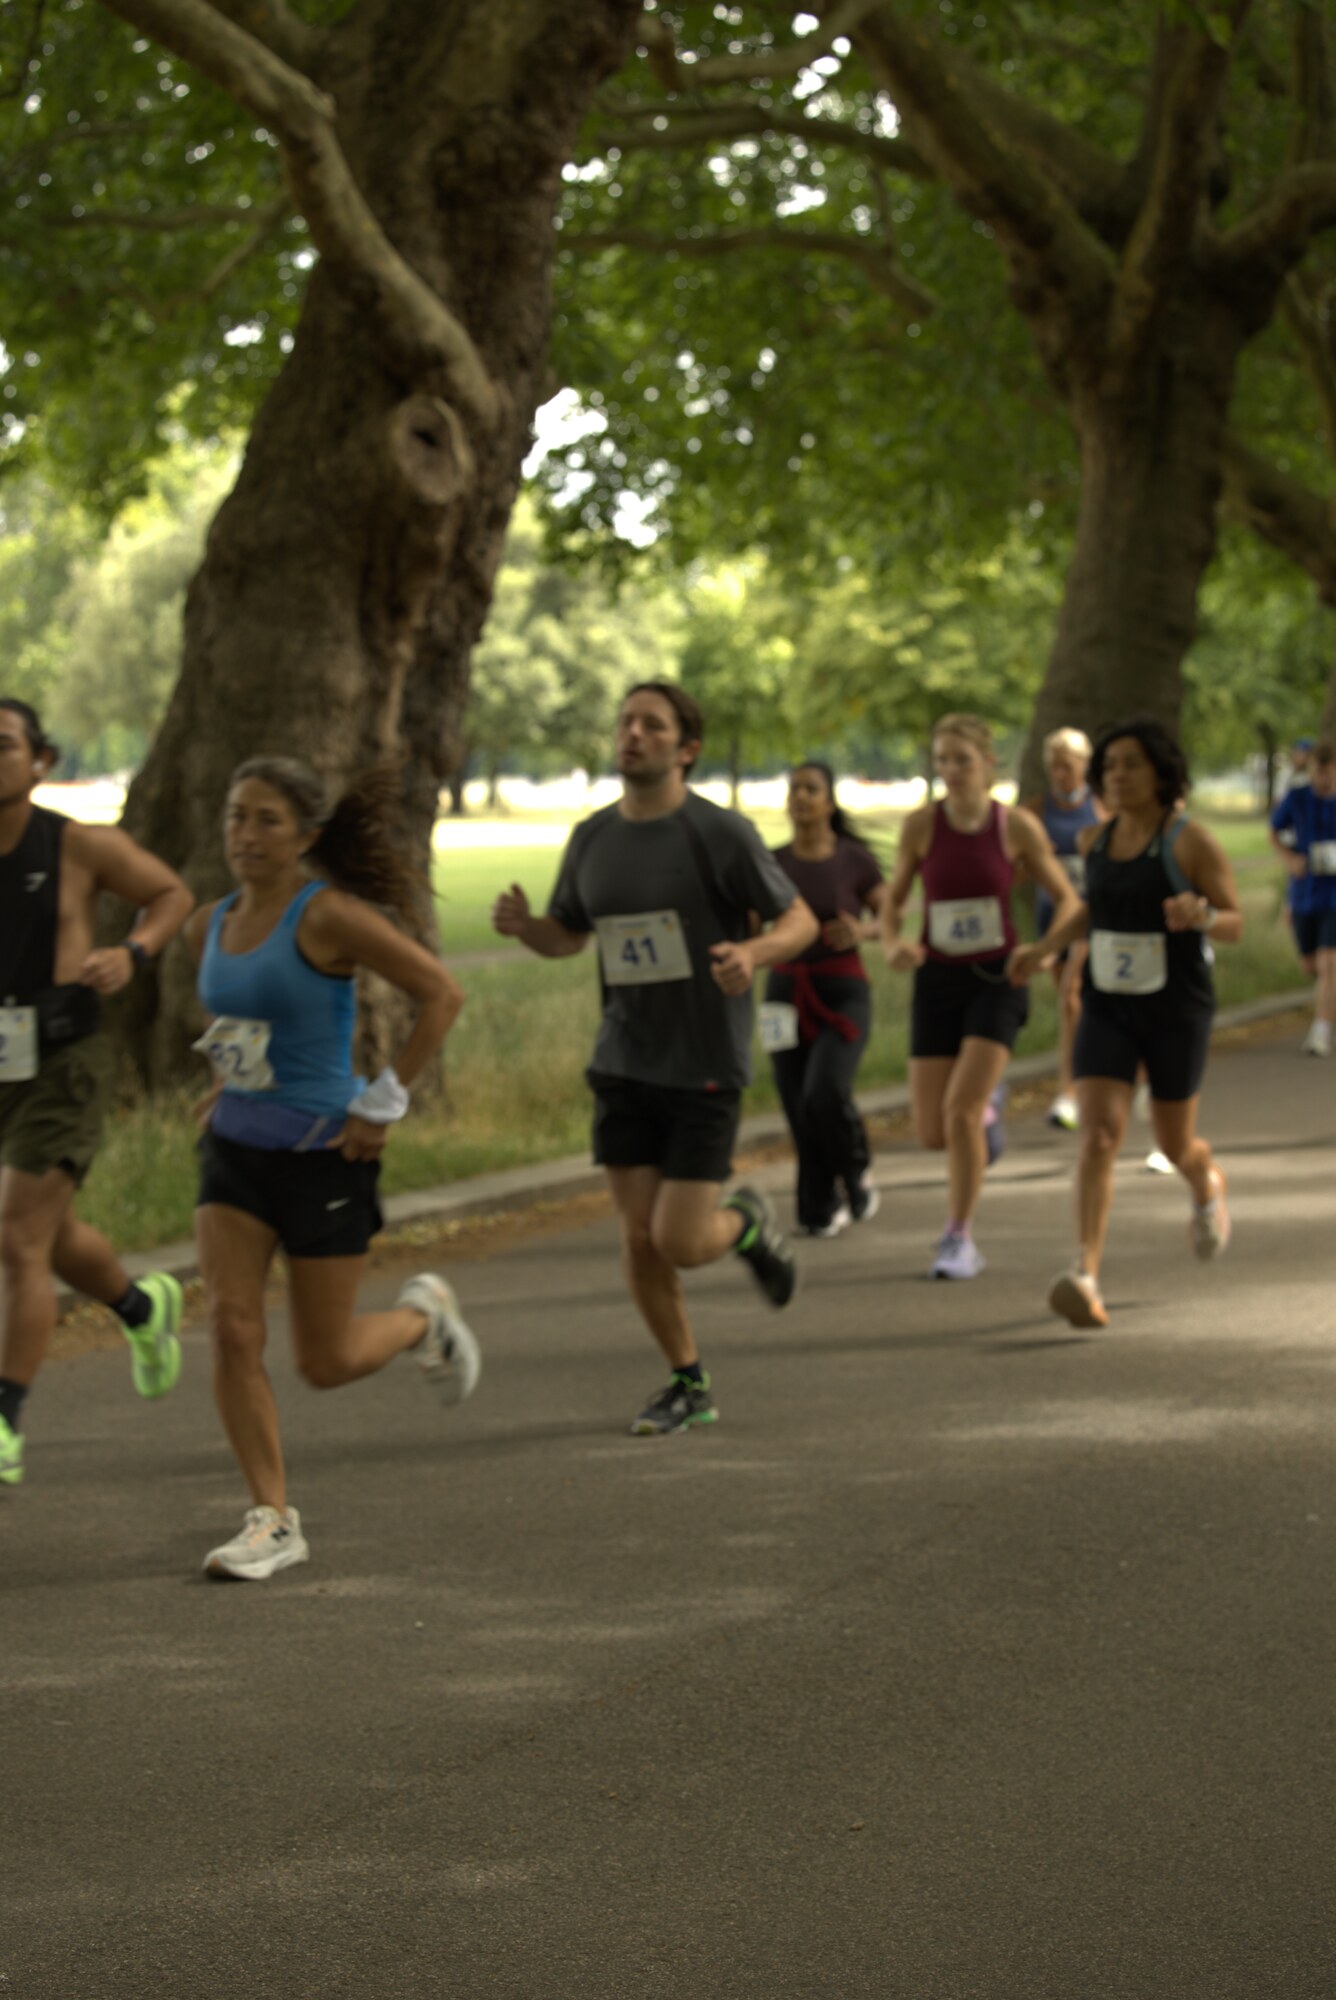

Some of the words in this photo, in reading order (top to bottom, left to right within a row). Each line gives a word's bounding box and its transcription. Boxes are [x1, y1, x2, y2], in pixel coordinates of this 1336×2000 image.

[949, 916, 982, 941] 48
[622, 937, 658, 966] 41
[1115, 952, 1135, 979] 2
